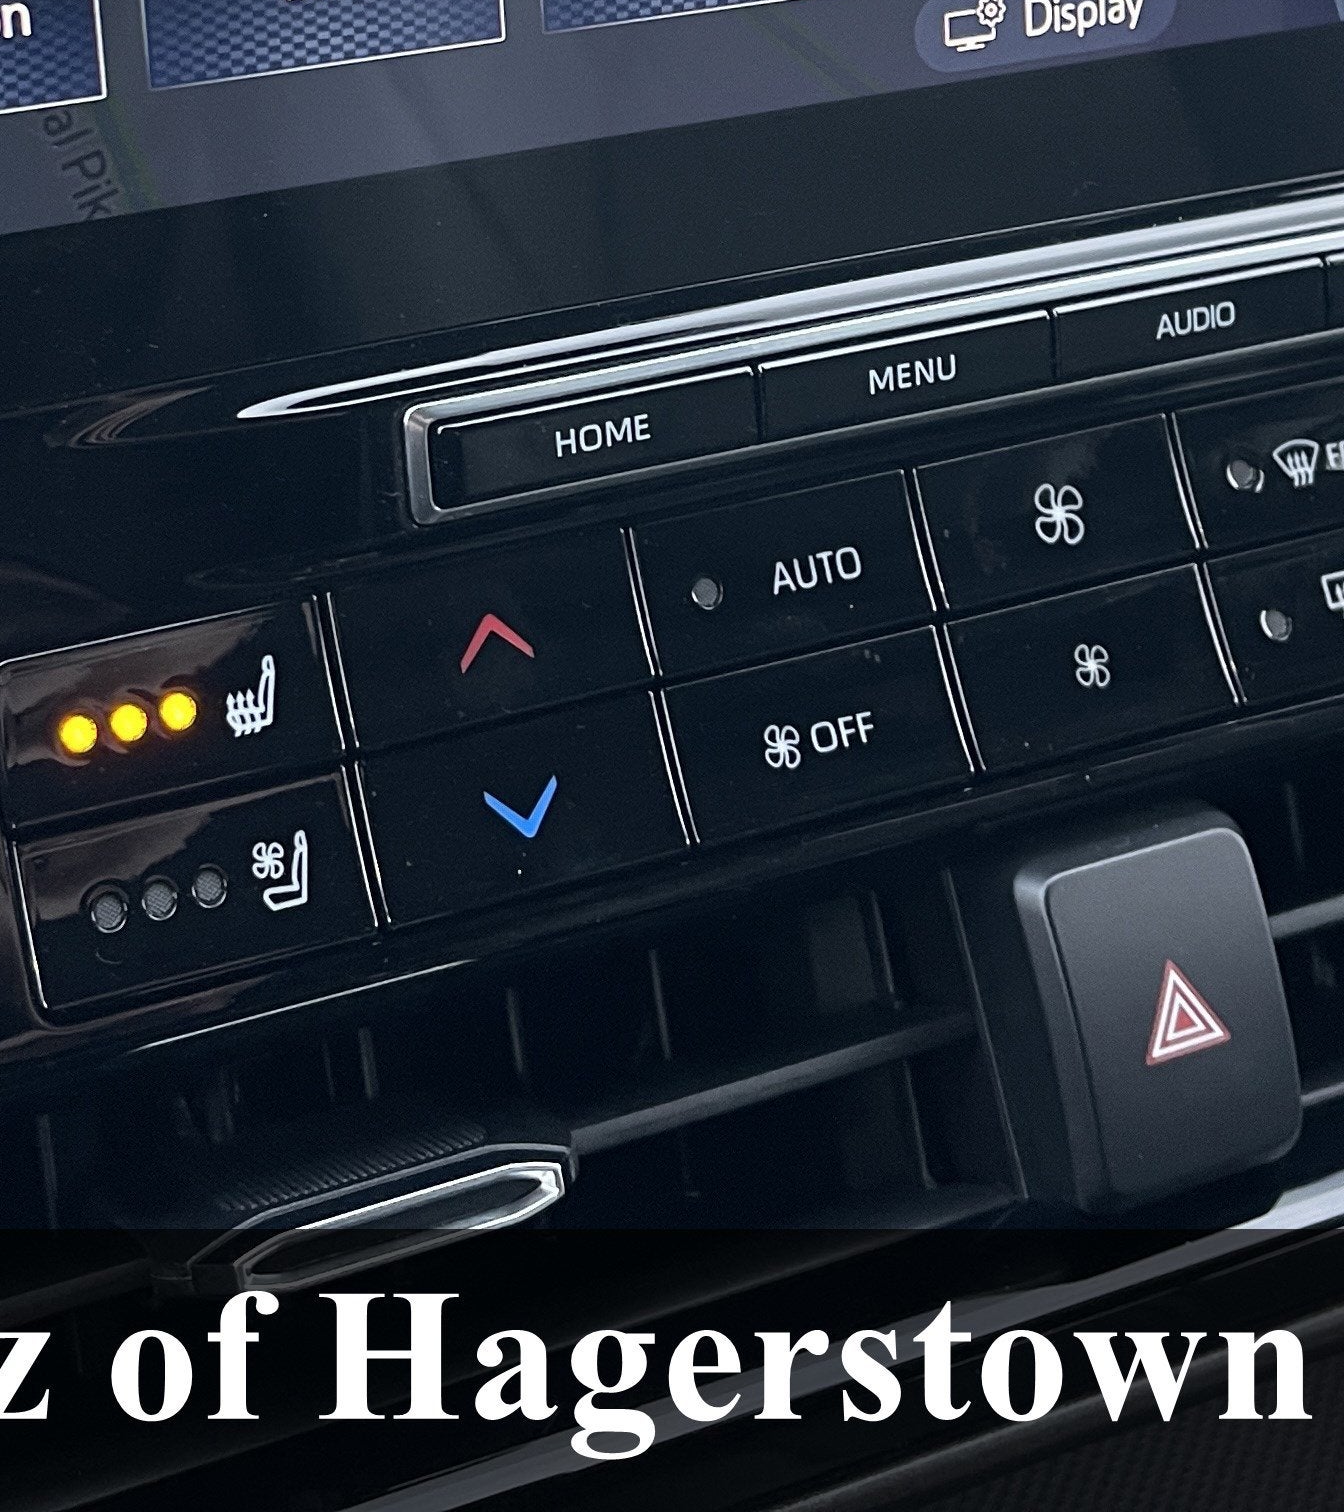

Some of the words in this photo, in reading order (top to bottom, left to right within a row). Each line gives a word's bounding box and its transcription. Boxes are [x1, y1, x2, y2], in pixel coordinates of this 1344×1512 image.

[1155, 298, 1236, 342] AUDIO
[867, 353, 958, 396] MENU
[556, 413, 652, 459] HOME
[771, 546, 863, 597] AUTO
[810, 711, 875, 754] OFF
